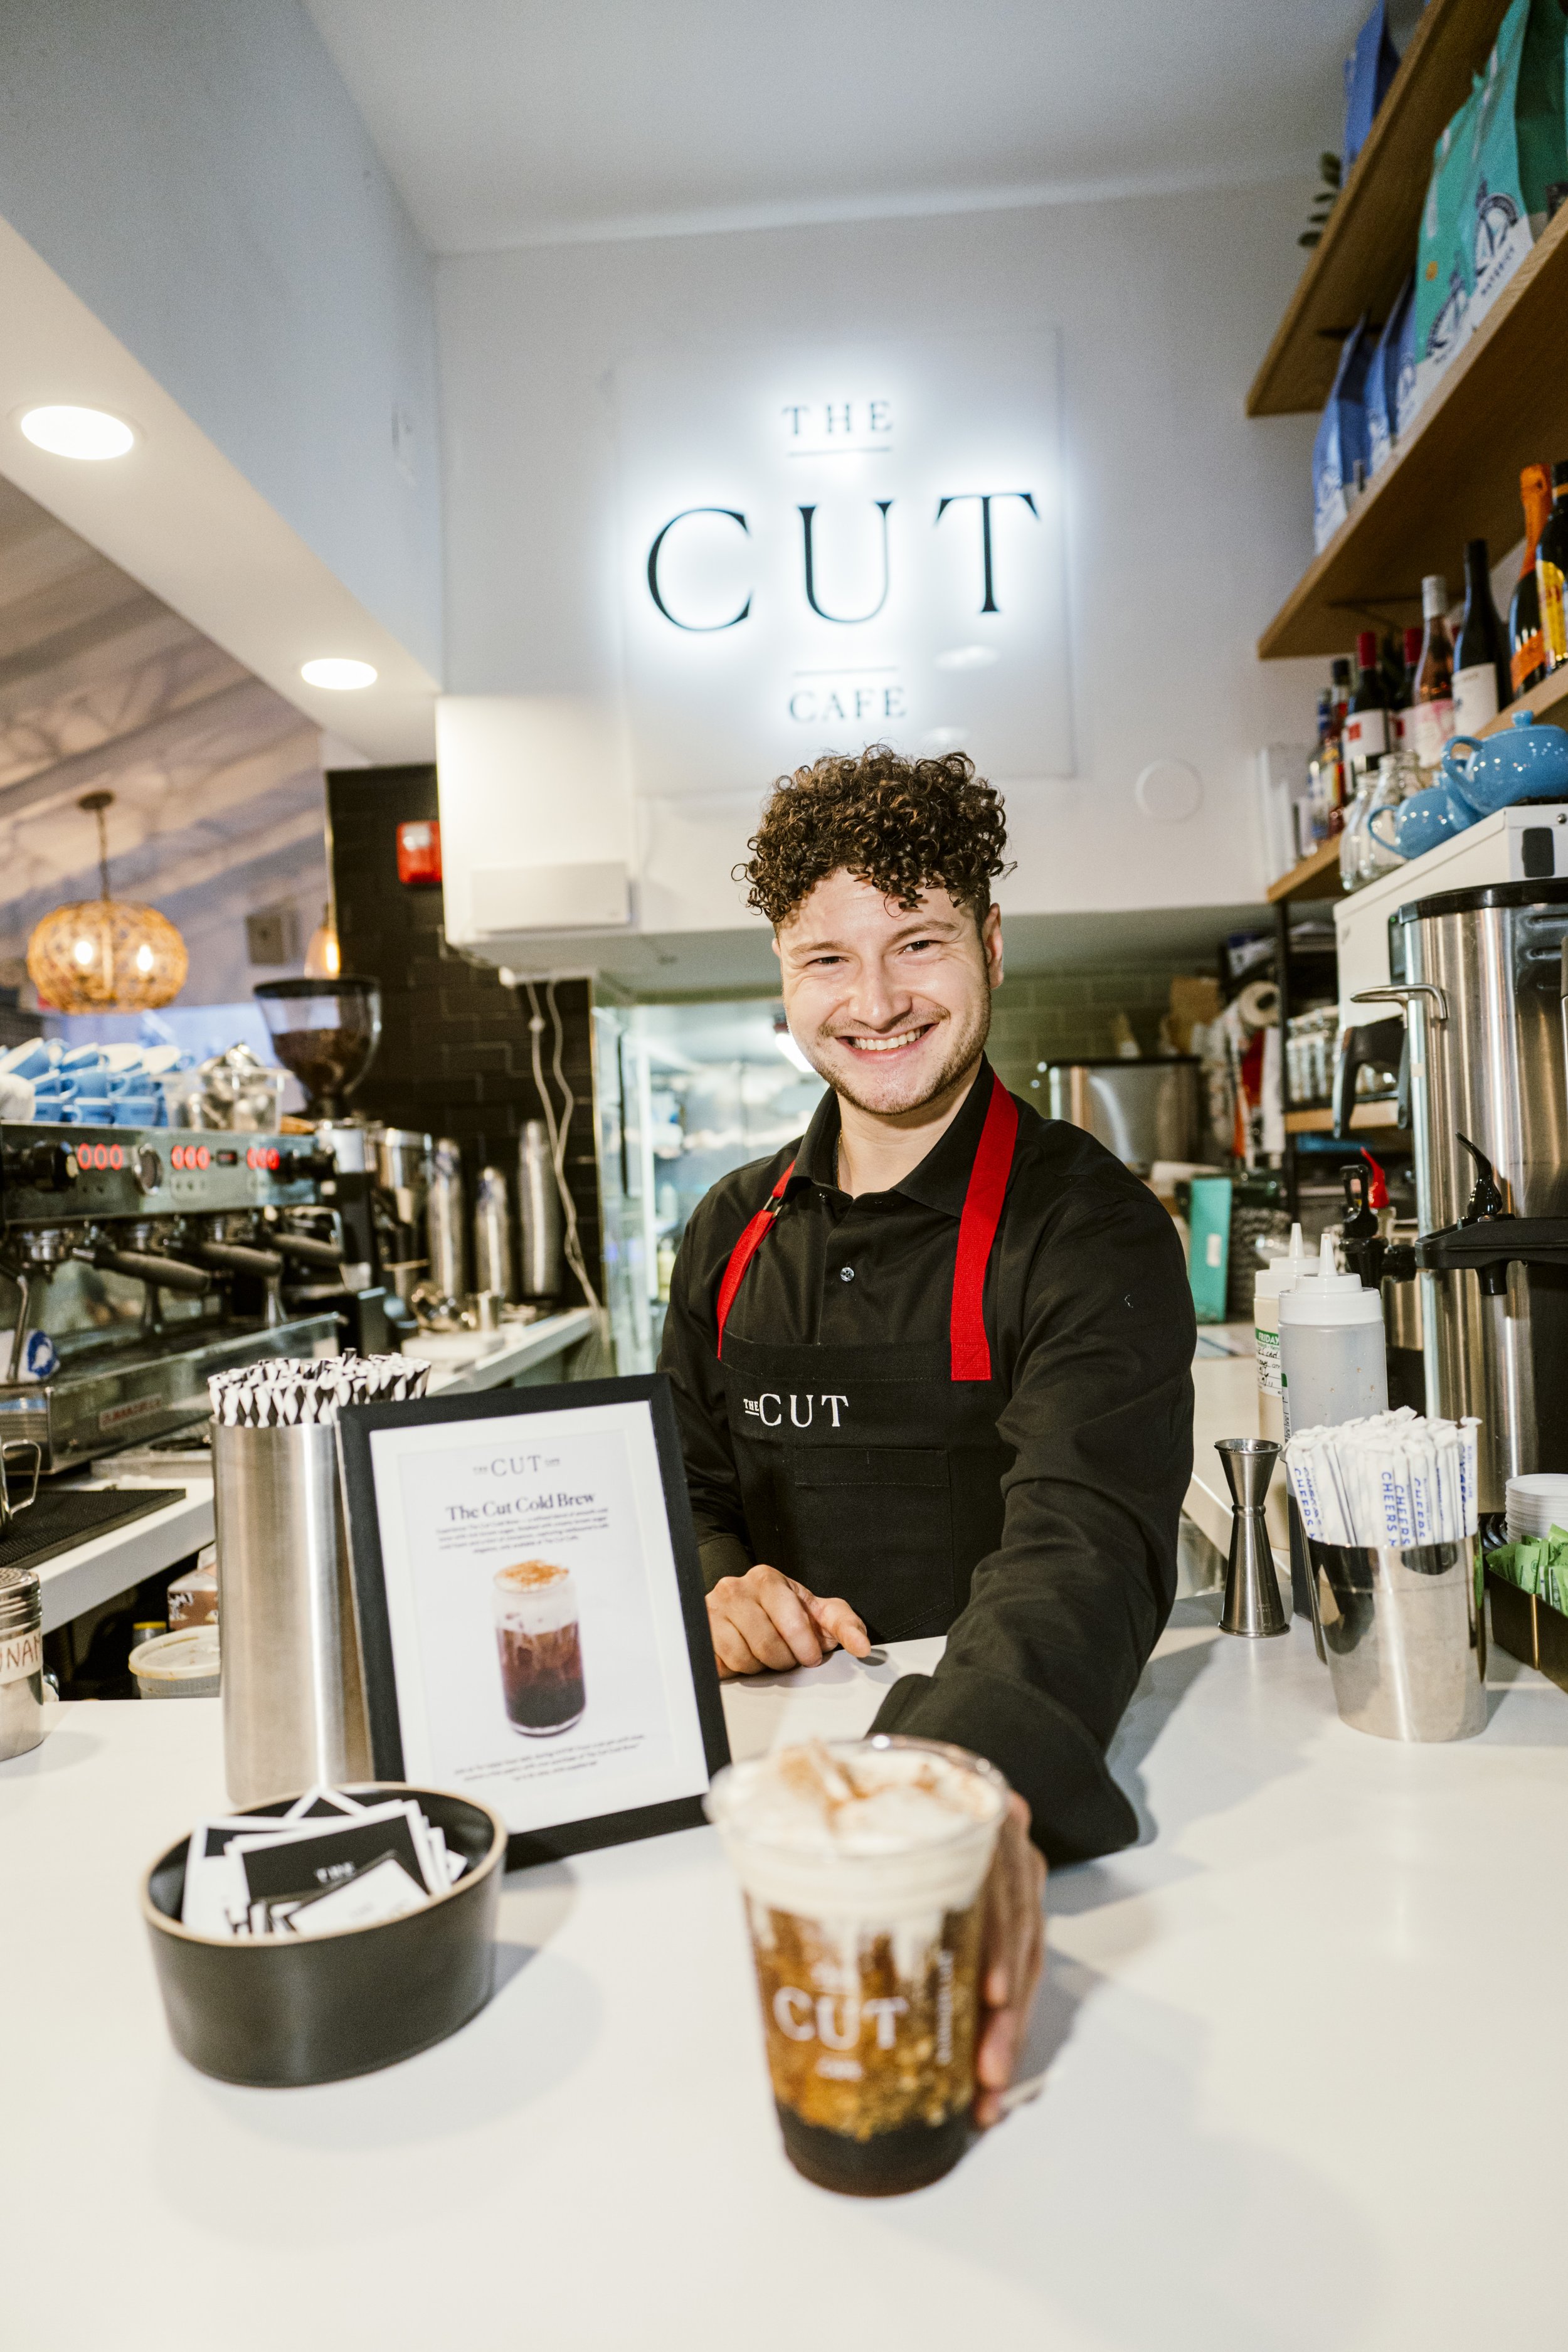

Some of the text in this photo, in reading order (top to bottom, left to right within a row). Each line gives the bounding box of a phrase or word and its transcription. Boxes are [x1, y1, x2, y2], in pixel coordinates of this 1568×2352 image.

[781, 400, 893, 435] THE
[647, 492, 1041, 632] CUT
[788, 687, 907, 723] CAFE
[1258, 1332, 1279, 1345] FRIDAY
[743, 1394, 849, 1428] THE CUT
[490, 1454, 541, 1477] CUT
[446, 1503, 479, 1522] The
[482, 1500, 512, 1518] Cut
[515, 1493, 554, 1514] Cold
[557, 1492, 596, 1508] Brew
[1382, 1471, 1397, 1532] CHEERS
[772, 1986, 909, 2051] CUT
